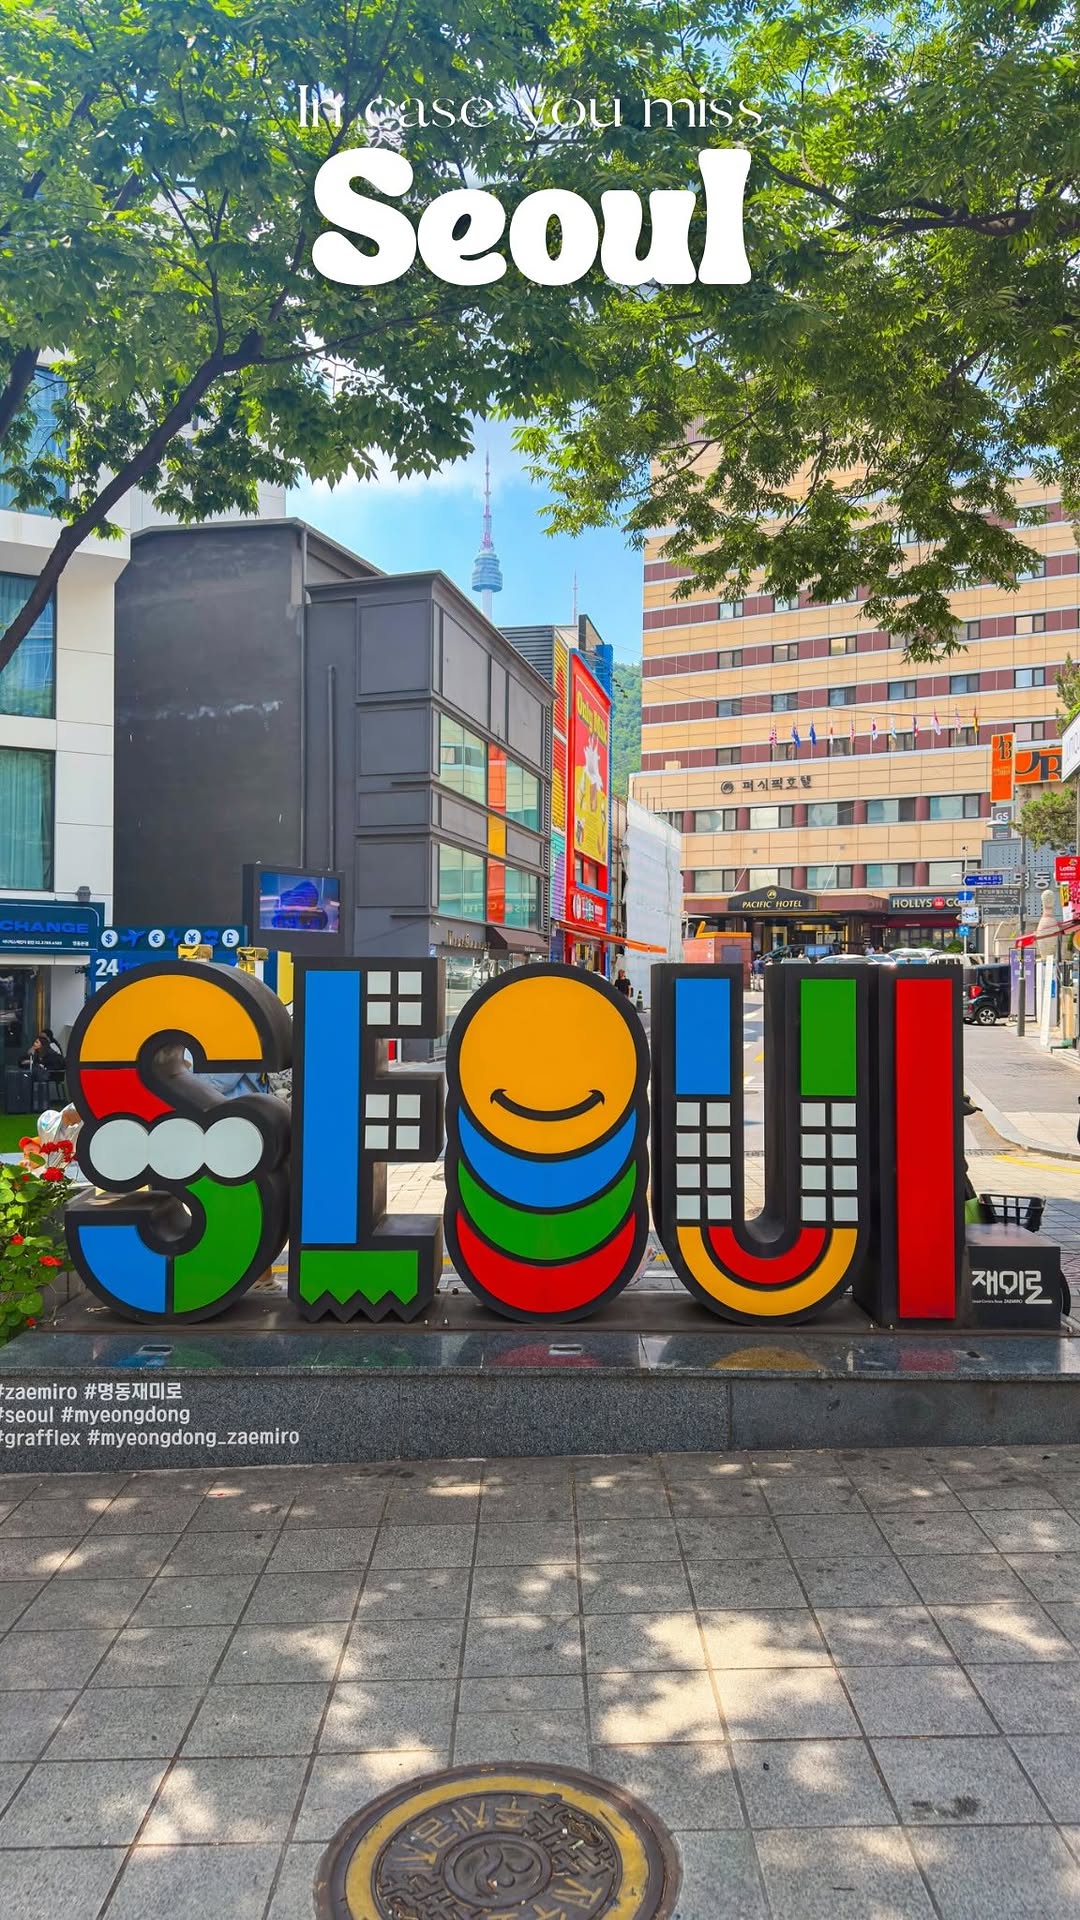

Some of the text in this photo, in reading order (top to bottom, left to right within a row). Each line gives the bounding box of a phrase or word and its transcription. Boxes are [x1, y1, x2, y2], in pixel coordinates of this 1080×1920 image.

[742, 899, 802, 909] PACIFIC HOTEL
[892, 898, 932, 909] HOLLYS
[0, 919, 88, 934] CHANGE
[95, 958, 119, 976] 24
[63, 957, 1060, 1326] SEOUL
[971, 1270, 1053, 1305] 재미로
[84, 1382, 183, 1400] #명동재미로
[61, 1405, 191, 1425] #myeongdong
[87, 1427, 300, 1448] #myeongdong_zaemiro
